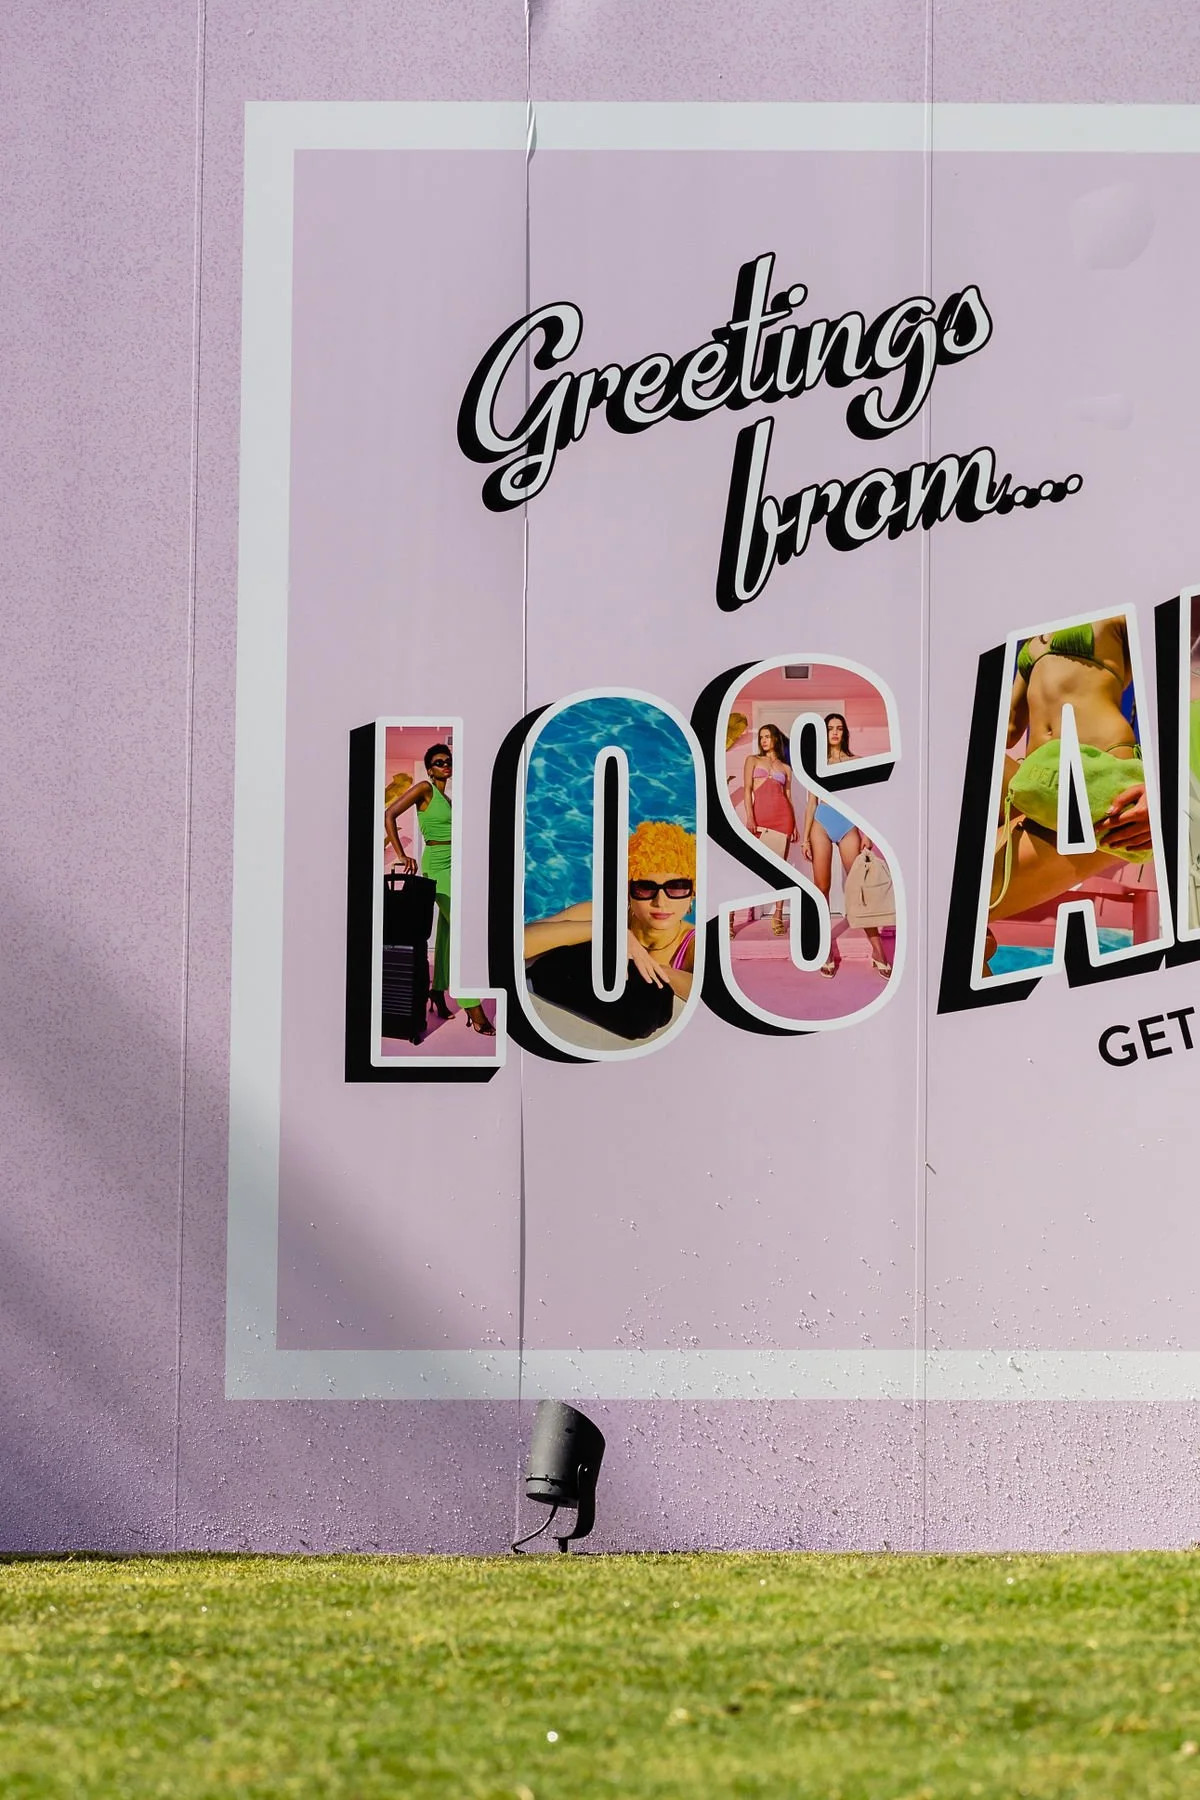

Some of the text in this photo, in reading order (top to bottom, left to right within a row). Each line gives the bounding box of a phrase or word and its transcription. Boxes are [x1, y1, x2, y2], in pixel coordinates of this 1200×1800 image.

[457, 252, 993, 512] Greetings
[345, 653, 907, 1082] LOS
[1099, 1007, 1195, 1066] GET
